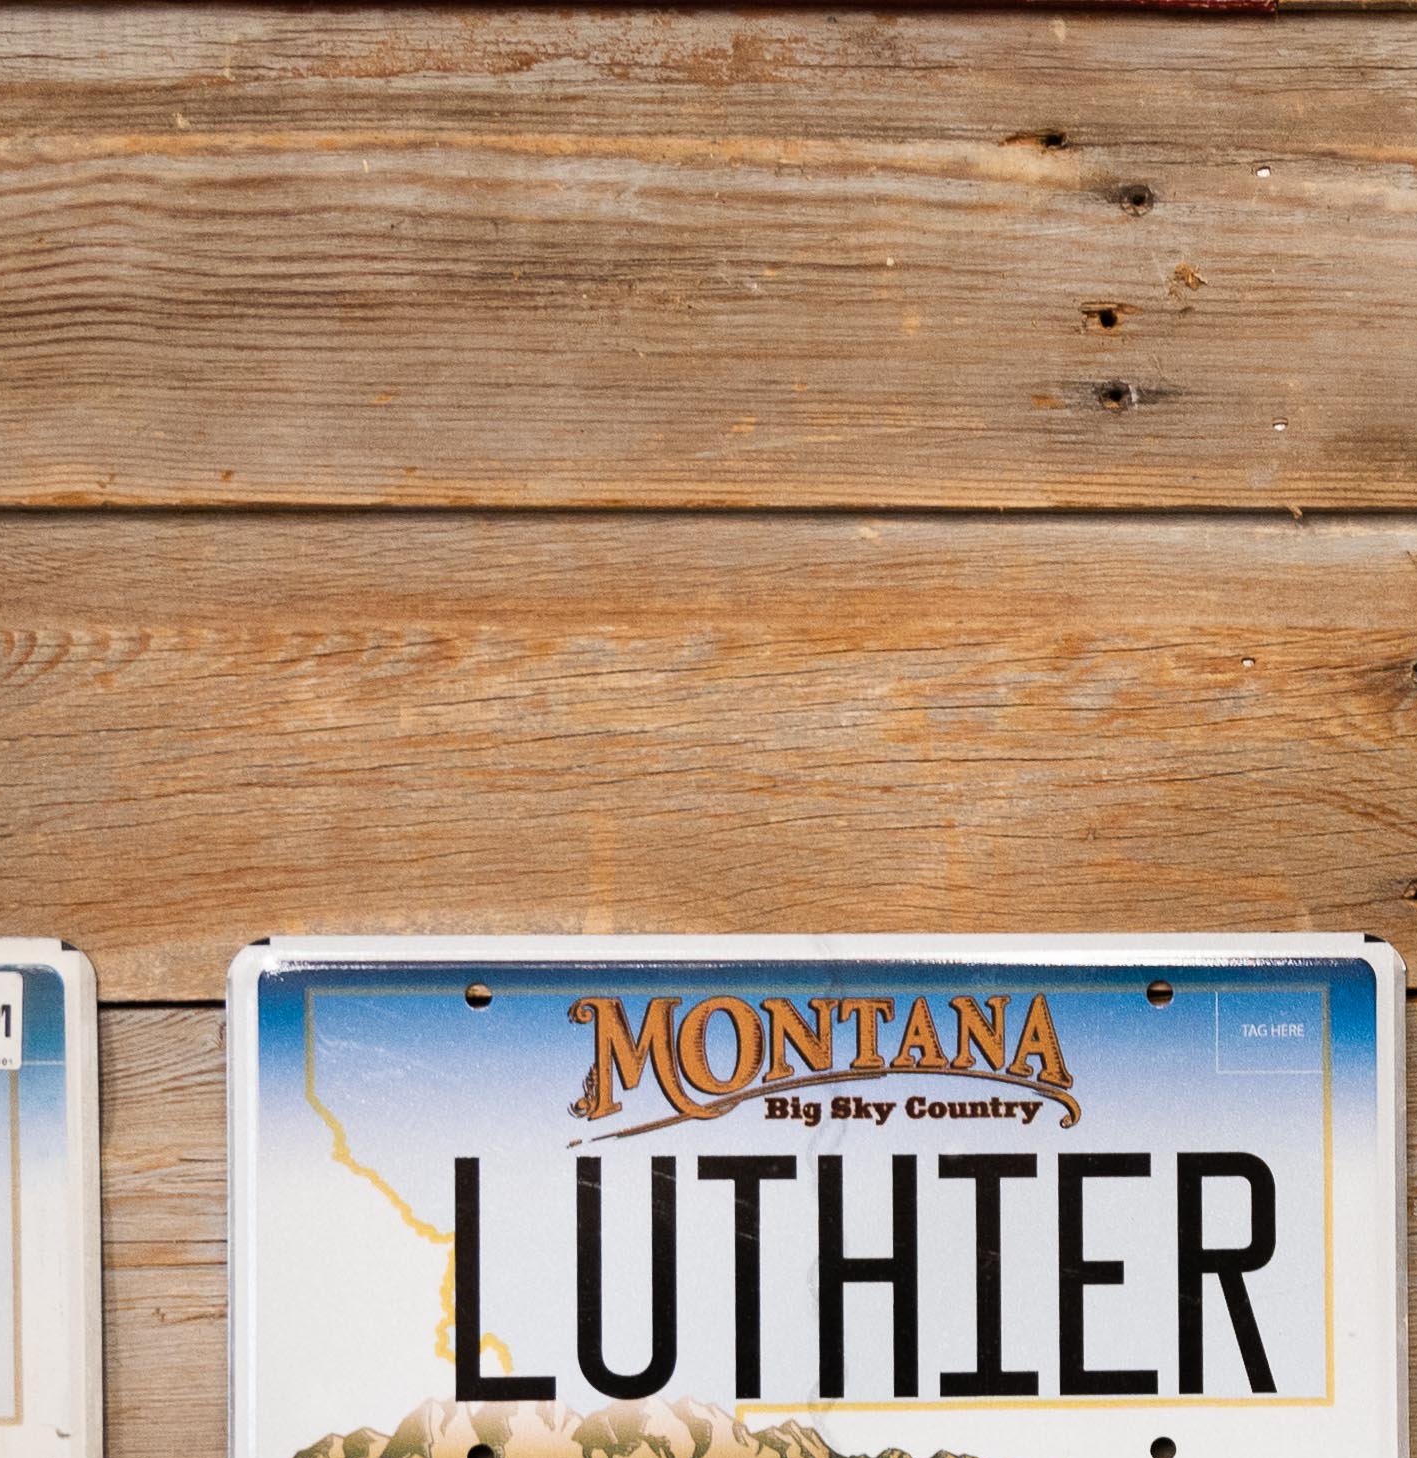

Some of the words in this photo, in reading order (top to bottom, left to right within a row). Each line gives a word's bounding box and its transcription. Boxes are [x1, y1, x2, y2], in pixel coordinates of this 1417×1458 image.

[568, 993, 1074, 1120] MONTANA
[1241, 1023, 1268, 1038] TAG
[1270, 1023, 1305, 1038] HERE
[764, 1096, 822, 1127] Big
[830, 1096, 897, 1126] Sky
[904, 1095, 1044, 1125] Country
[454, 1151, 1278, 1403] LUTHIER
